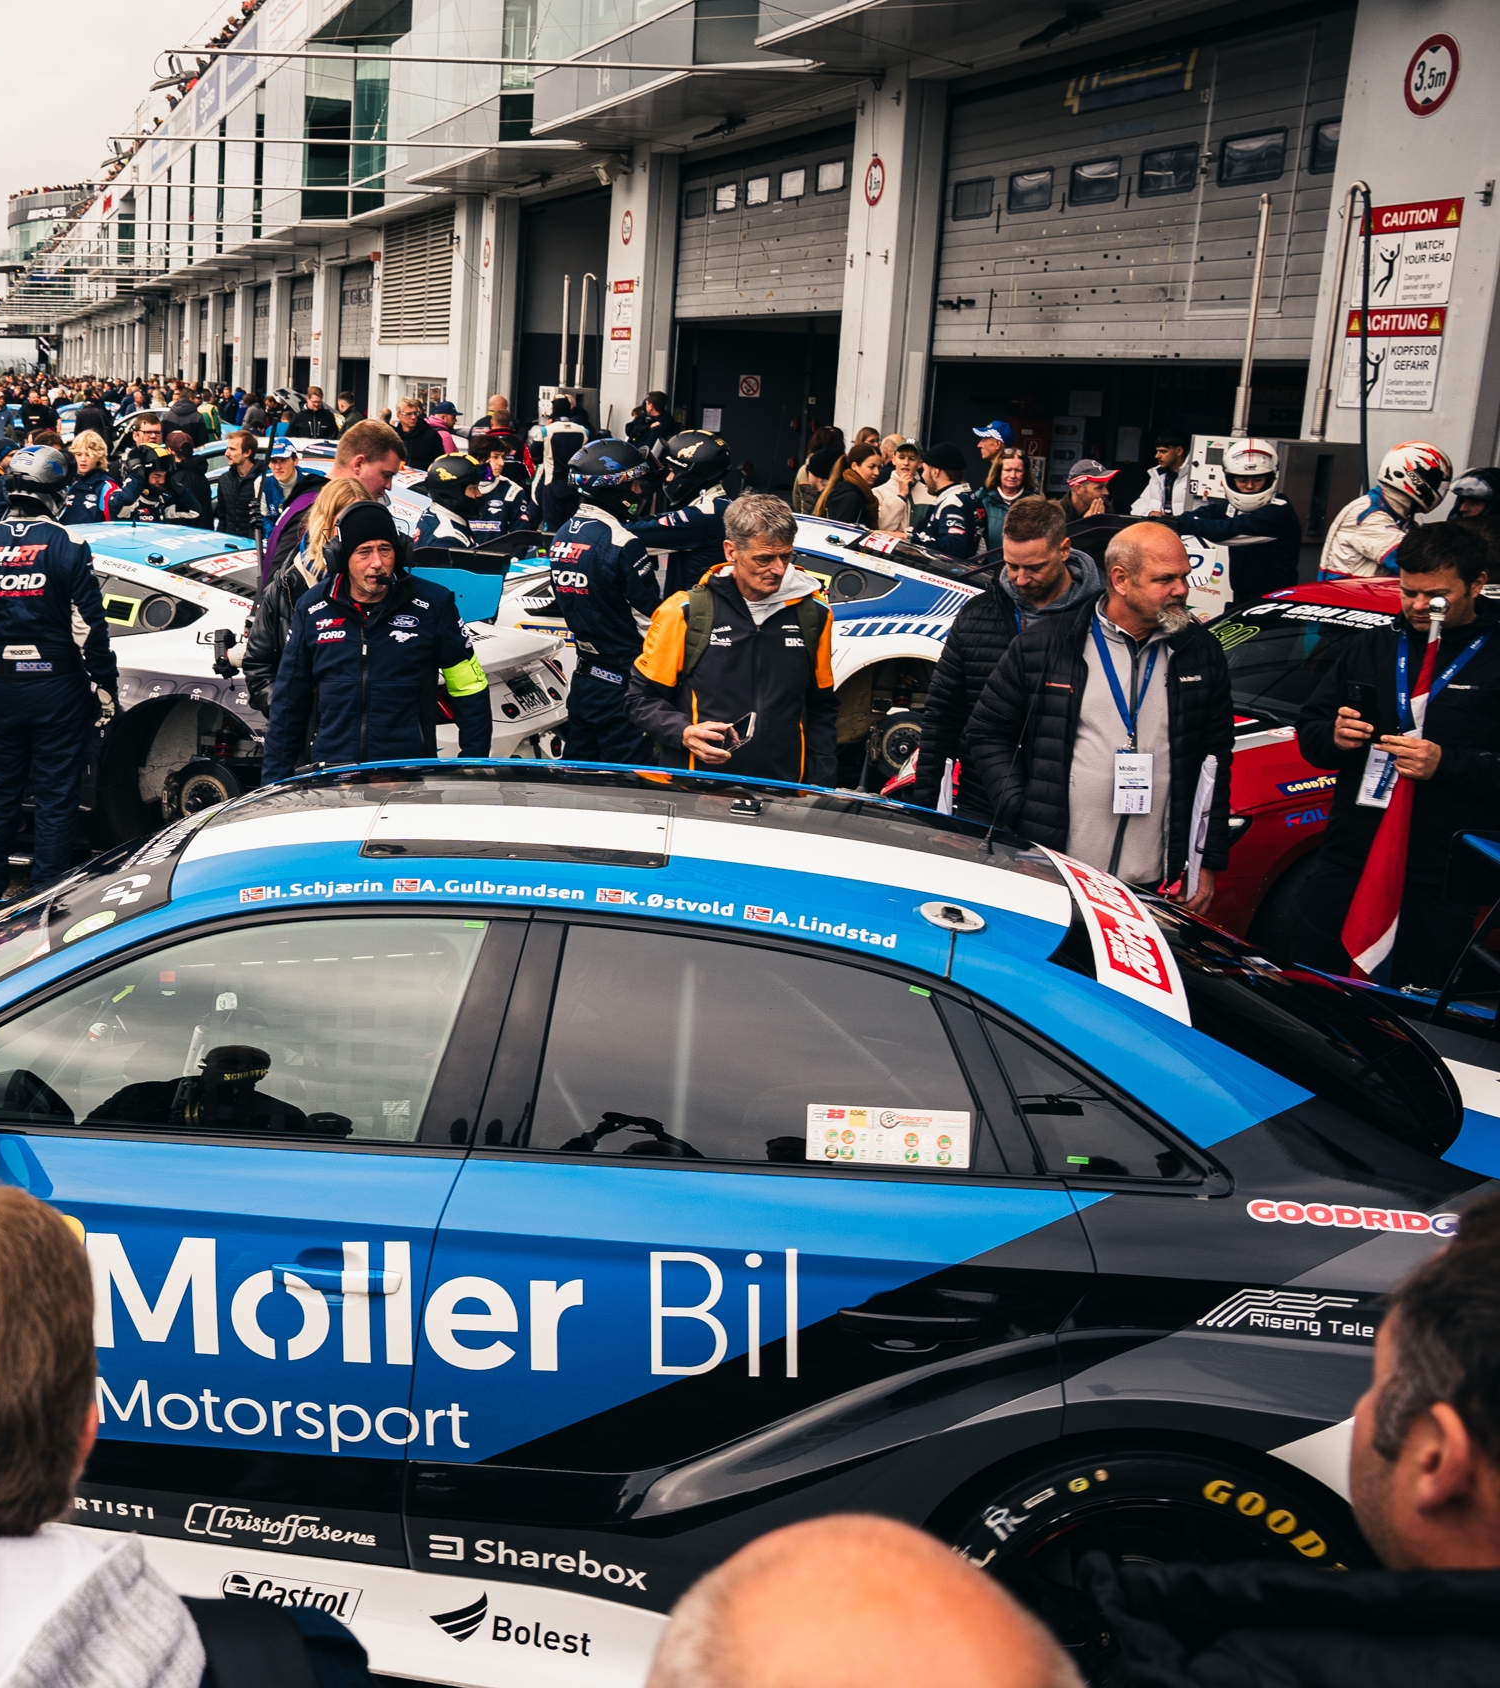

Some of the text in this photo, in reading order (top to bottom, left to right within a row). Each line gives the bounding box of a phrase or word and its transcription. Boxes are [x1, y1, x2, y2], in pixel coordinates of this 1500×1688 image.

[1382, 208, 1438, 227] CAUTION
[1415, 240, 1445, 250] WATCH
[1404, 252, 1452, 264] YOUR HEAD
[1394, 360, 1430, 370] GEFAHR
[102, 560, 138, 574] SCHERER
[1337, 609, 1396, 626] TURIS
[318, 630, 346, 640] FORD
[16, 662, 53, 672] sparco
[591, 665, 623, 684] sparco
[850, 1109, 867, 1117] ADAC
[1248, 1201, 1459, 1236] GOODRIDG
[650, 1247, 799, 1378] Bil
[1250, 1312, 1322, 1336] Riseng
[94, 1377, 471, 1453] Motorsport
[74, 1497, 155, 1520] RTISTI
[474, 1538, 648, 1592] Sharebox
[491, 1615, 592, 1657] Bolest
